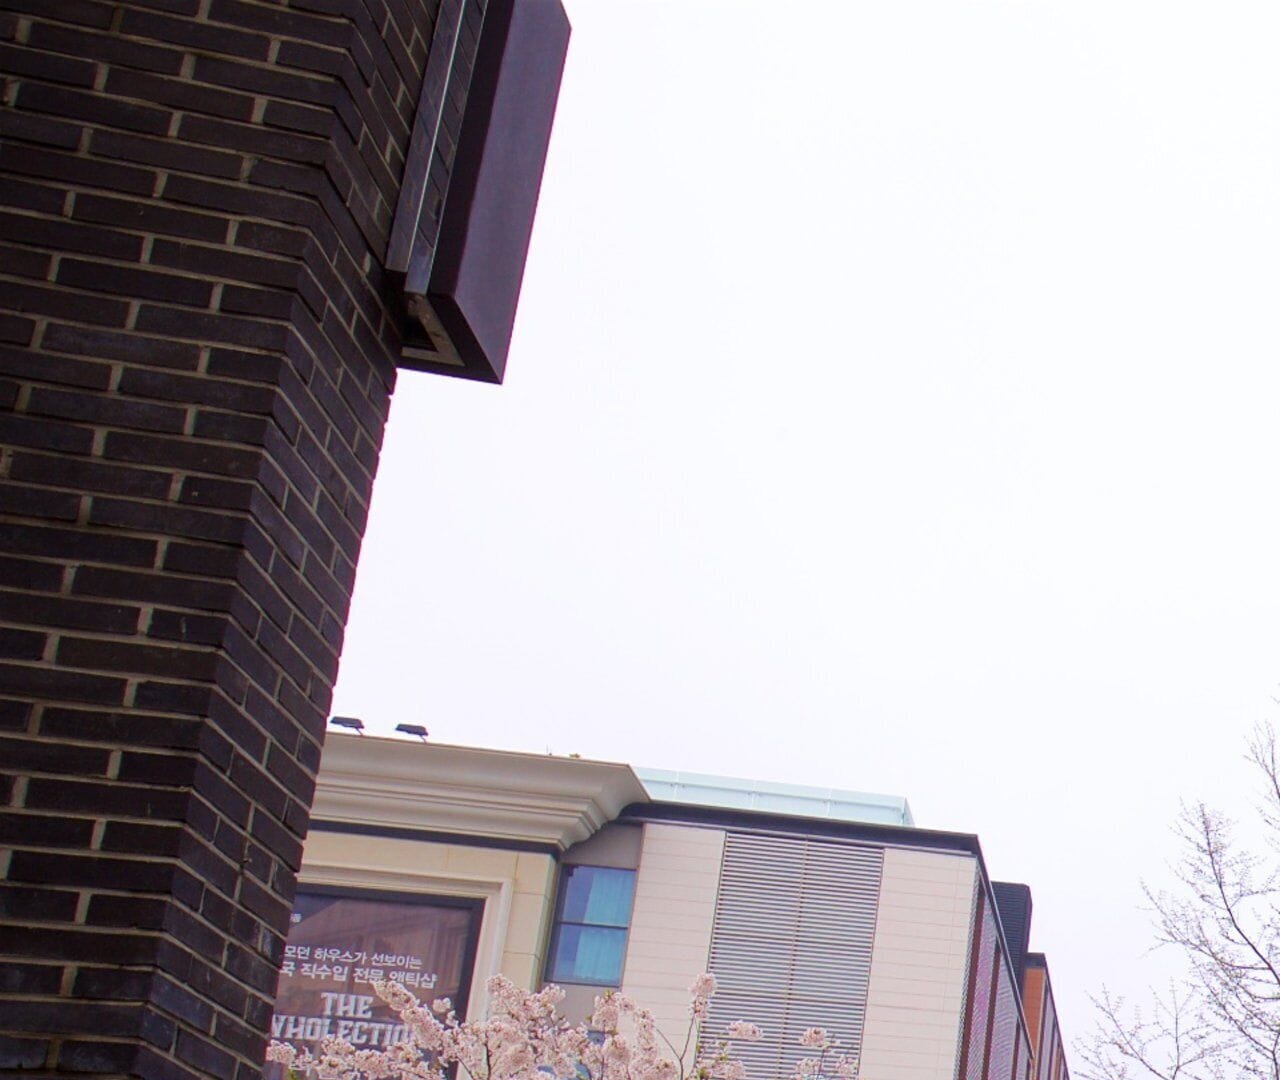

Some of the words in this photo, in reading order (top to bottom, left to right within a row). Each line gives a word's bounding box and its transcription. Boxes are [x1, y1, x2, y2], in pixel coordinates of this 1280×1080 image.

[314, 948, 367, 964] 하우스가
[371, 953, 423, 970] 선보이는
[301, 962, 348, 981] 직수입
[321, 991, 374, 1018] THE
